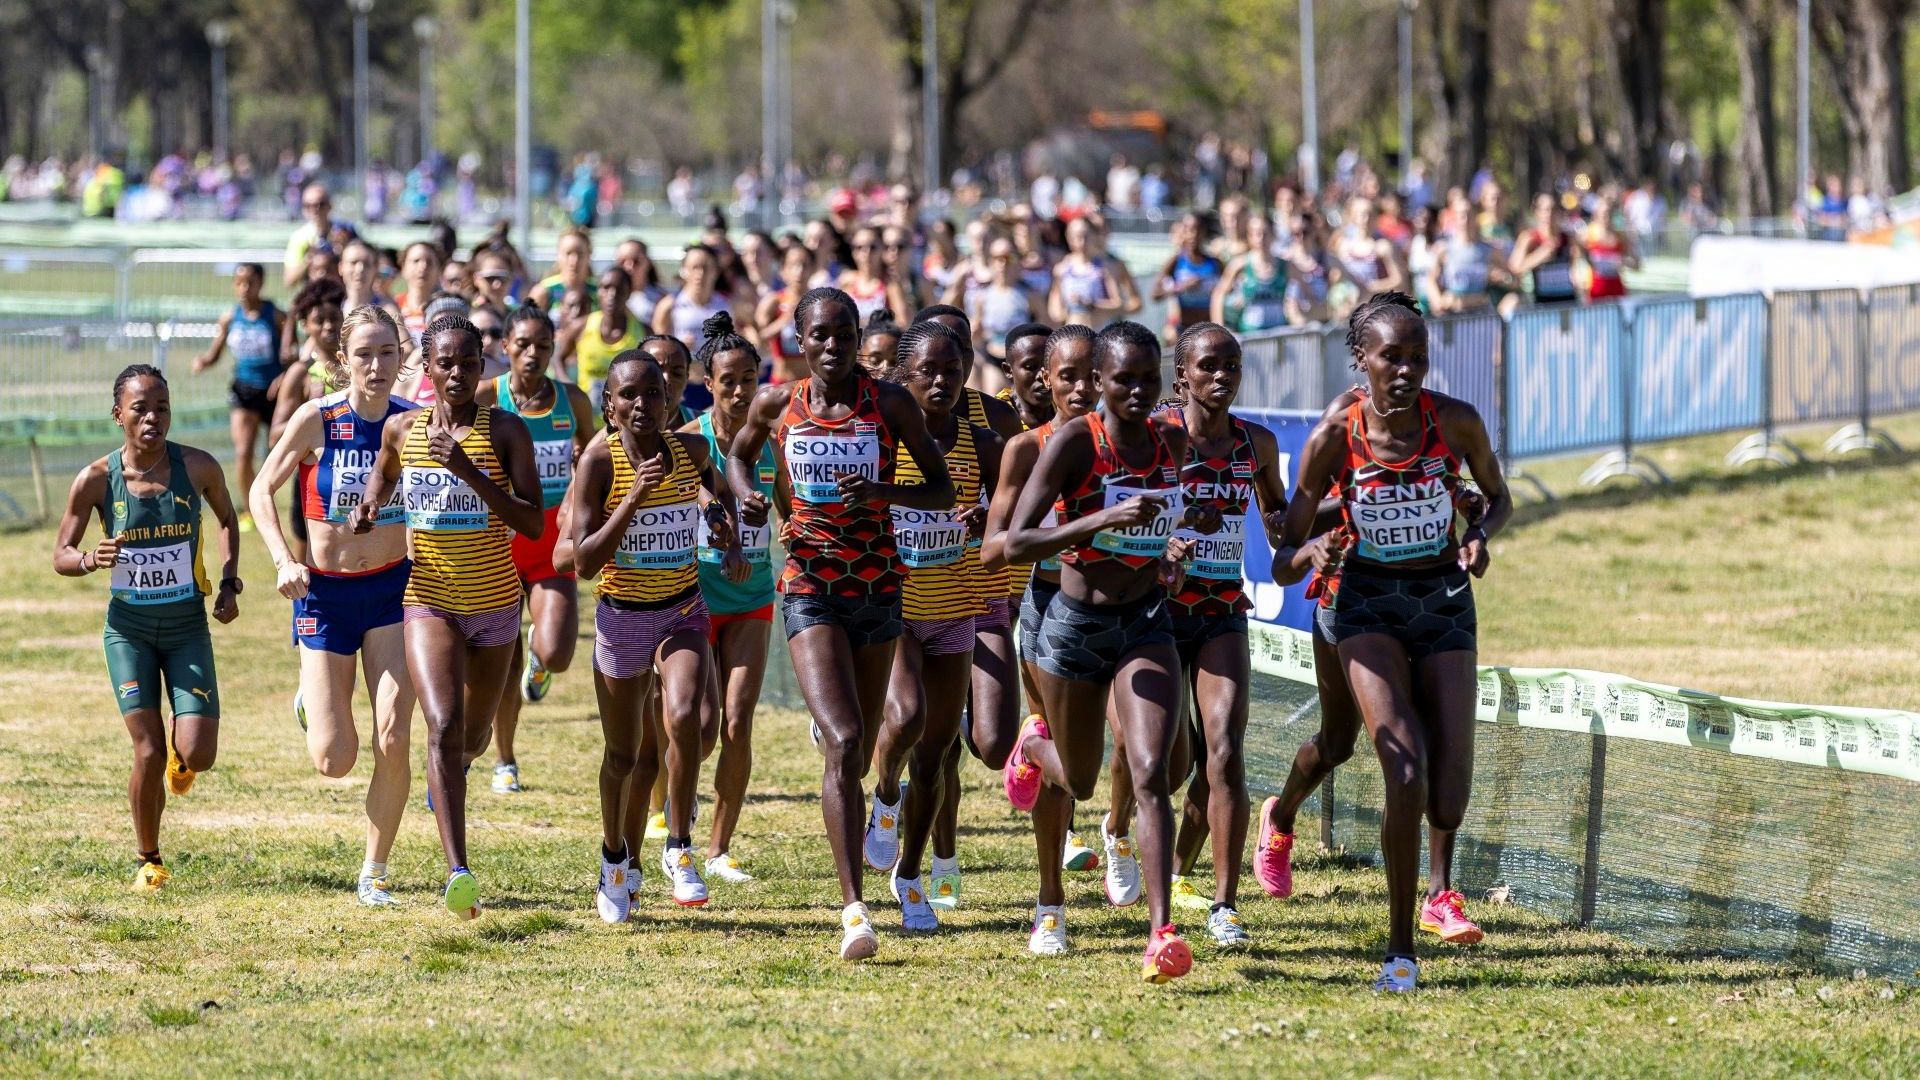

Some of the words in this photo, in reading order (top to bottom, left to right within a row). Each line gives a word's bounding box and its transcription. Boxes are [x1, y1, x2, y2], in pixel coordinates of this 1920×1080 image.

[534, 444, 568, 457] NY
[793, 441, 870, 456] SONY
[411, 472, 459, 487] SON
[1180, 483, 1250, 500] KENYA
[1355, 477, 1448, 504] KENYA
[408, 493, 418, 511] S.
[421, 493, 484, 512] CHELANGAT
[394, 510, 404, 518] 24
[629, 508, 692, 527] SONY
[890, 509, 958, 524] SONY
[1360, 500, 1443, 522] SONY
[426, 517, 469, 525] BELGRADE
[470, 517, 484, 525] 24
[154, 523, 192, 539] AFRICA
[1361, 518, 1448, 546] NGETICH
[620, 528, 694, 551] CHEPTOYEK
[895, 528, 961, 550] HEMUTAI
[1123, 541, 1163, 551] BELGRAD
[117, 548, 183, 566] SONY
[903, 552, 945, 563] BELGRADE
[946, 549, 958, 558] 24
[1385, 544, 1437, 558] BELGRADE
[641, 554, 685, 564] BELGRADE
[1197, 564, 1231, 575] BELGRADE
[128, 568, 178, 588] XABA
[135, 591, 178, 600] BELGRADE
[179, 587, 189, 596] 24
